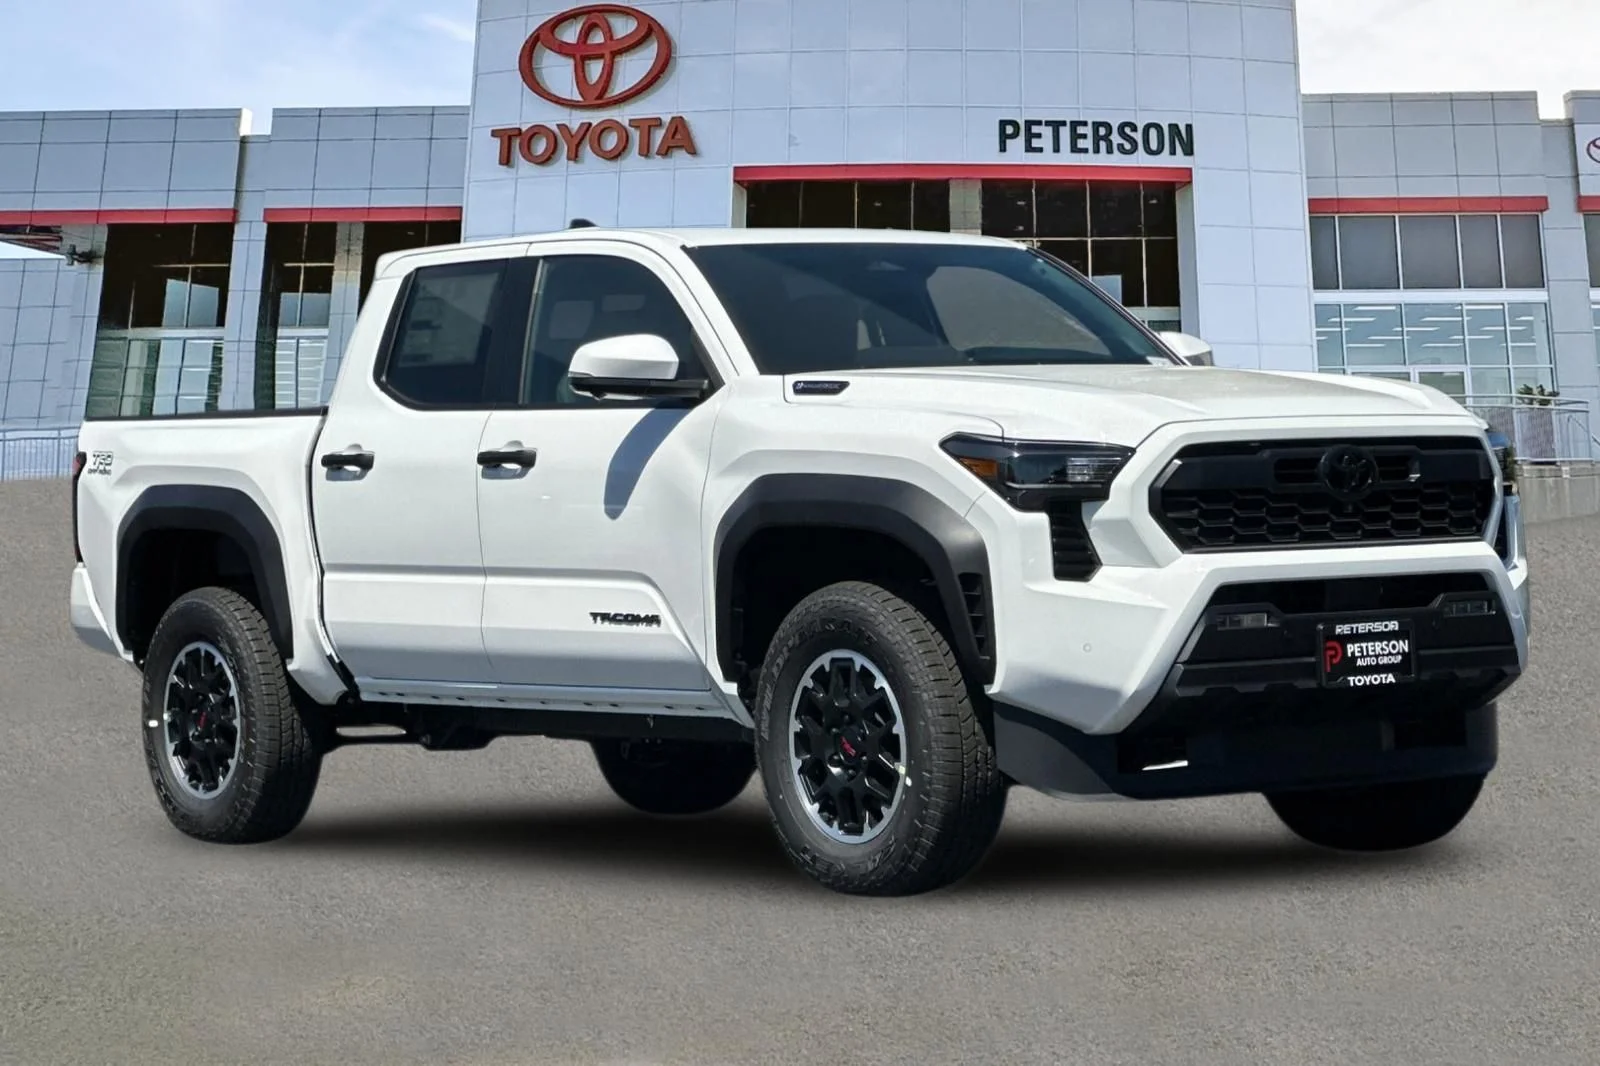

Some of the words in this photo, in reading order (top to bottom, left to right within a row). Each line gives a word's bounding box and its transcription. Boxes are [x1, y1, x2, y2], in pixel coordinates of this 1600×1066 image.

[491, 116, 697, 166] TOYOTA
[998, 119, 1194, 156] PETERSON
[589, 612, 661, 627] TACOMA
[1346, 639, 1409, 657] PETERSON
[1356, 657, 1377, 667] AUTO
[1377, 655, 1402, 664] GROUP
[1347, 673, 1396, 687] TOYOTA
